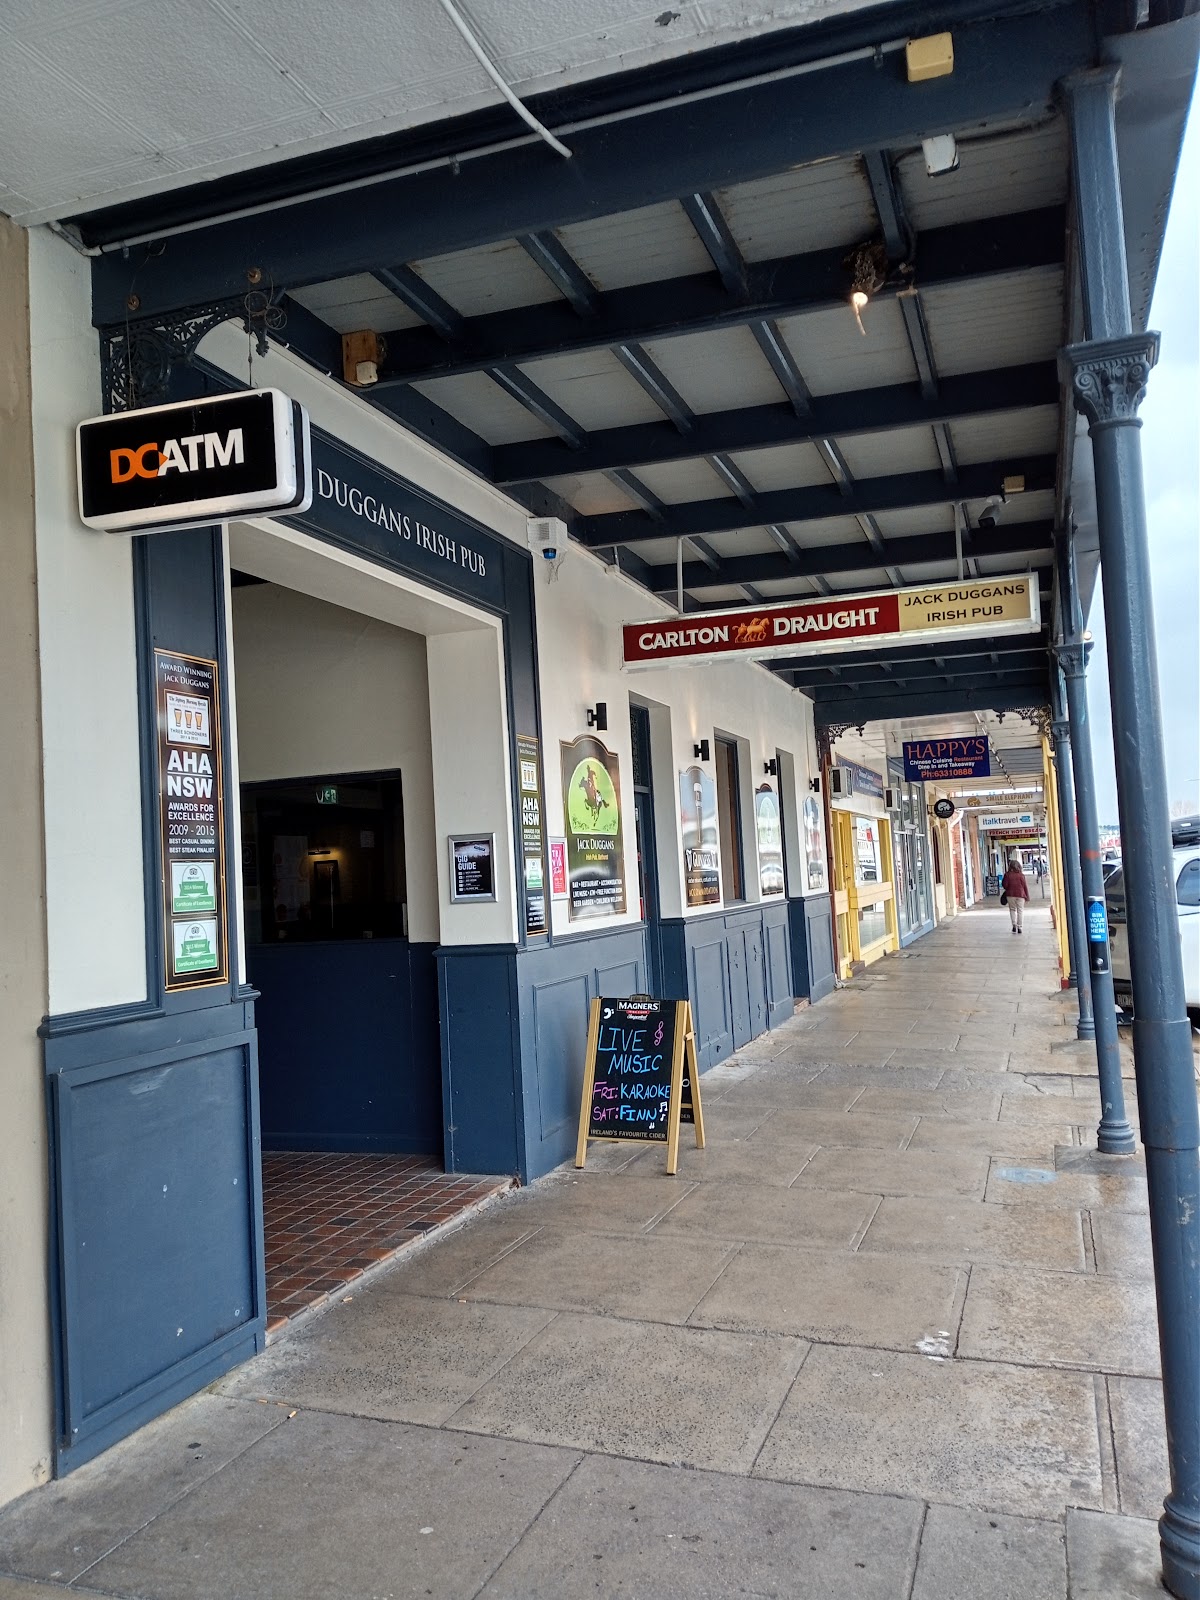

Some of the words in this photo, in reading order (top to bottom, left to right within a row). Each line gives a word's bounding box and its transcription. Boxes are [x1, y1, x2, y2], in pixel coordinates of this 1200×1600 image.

[316, 468, 412, 541] DUGGANS
[415, 521, 458, 564] IRISH
[460, 544, 486, 577] PUB
[904, 593, 944, 607] JACK
[948, 584, 1026, 602] DUGGANS
[927, 609, 967, 622] IRISH
[972, 605, 1004, 618] PUB
[638, 625, 730, 651] CARLTON
[772, 607, 880, 637] DRAUGHT
[160, 661, 183, 673] AWARD
[183, 666, 213, 680] WINNING
[164, 673, 179, 683] JACK
[180, 676, 210, 690] DUGGANS
[906, 739, 985, 759] HAPPY'S
[167, 749, 213, 775] AHA
[909, 758, 932, 766] Chinese
[932, 757, 953, 765] Cuisine
[949, 760, 976, 768] Takeaway
[167, 775, 213, 799] NSW
[522, 796, 539, 811] AHA
[1004, 793, 1034, 801] ELEPHANT
[168, 802, 199, 812] AWARDS
[200, 804, 214, 813] FOR
[168, 812, 215, 822] EXCELLENCE
[522, 812, 540, 826] NSW
[168, 824, 189, 835] 2009
[195, 825, 215, 836] 2015
[577, 838, 591, 852] JACK
[590, 839, 615, 851] DUGGANS
[457, 855, 468, 863] GIG
[458, 862, 477, 871] GUIDE
[619, 1002, 659, 1011] MAGNERS
[598, 1025, 647, 1051] LIVE
[607, 1053, 663, 1075] MUSIC
[593, 1081, 619, 1100] FRI:
[620, 1082, 671, 1100] KARAOKE
[593, 1106, 619, 1121] SAT:
[620, 1105, 657, 1121] FINN
[590, 1129, 618, 1137] IRELAND'S
[618, 1130, 648, 1139] FAVOURITE
[648, 1132, 666, 1140] CIDER
